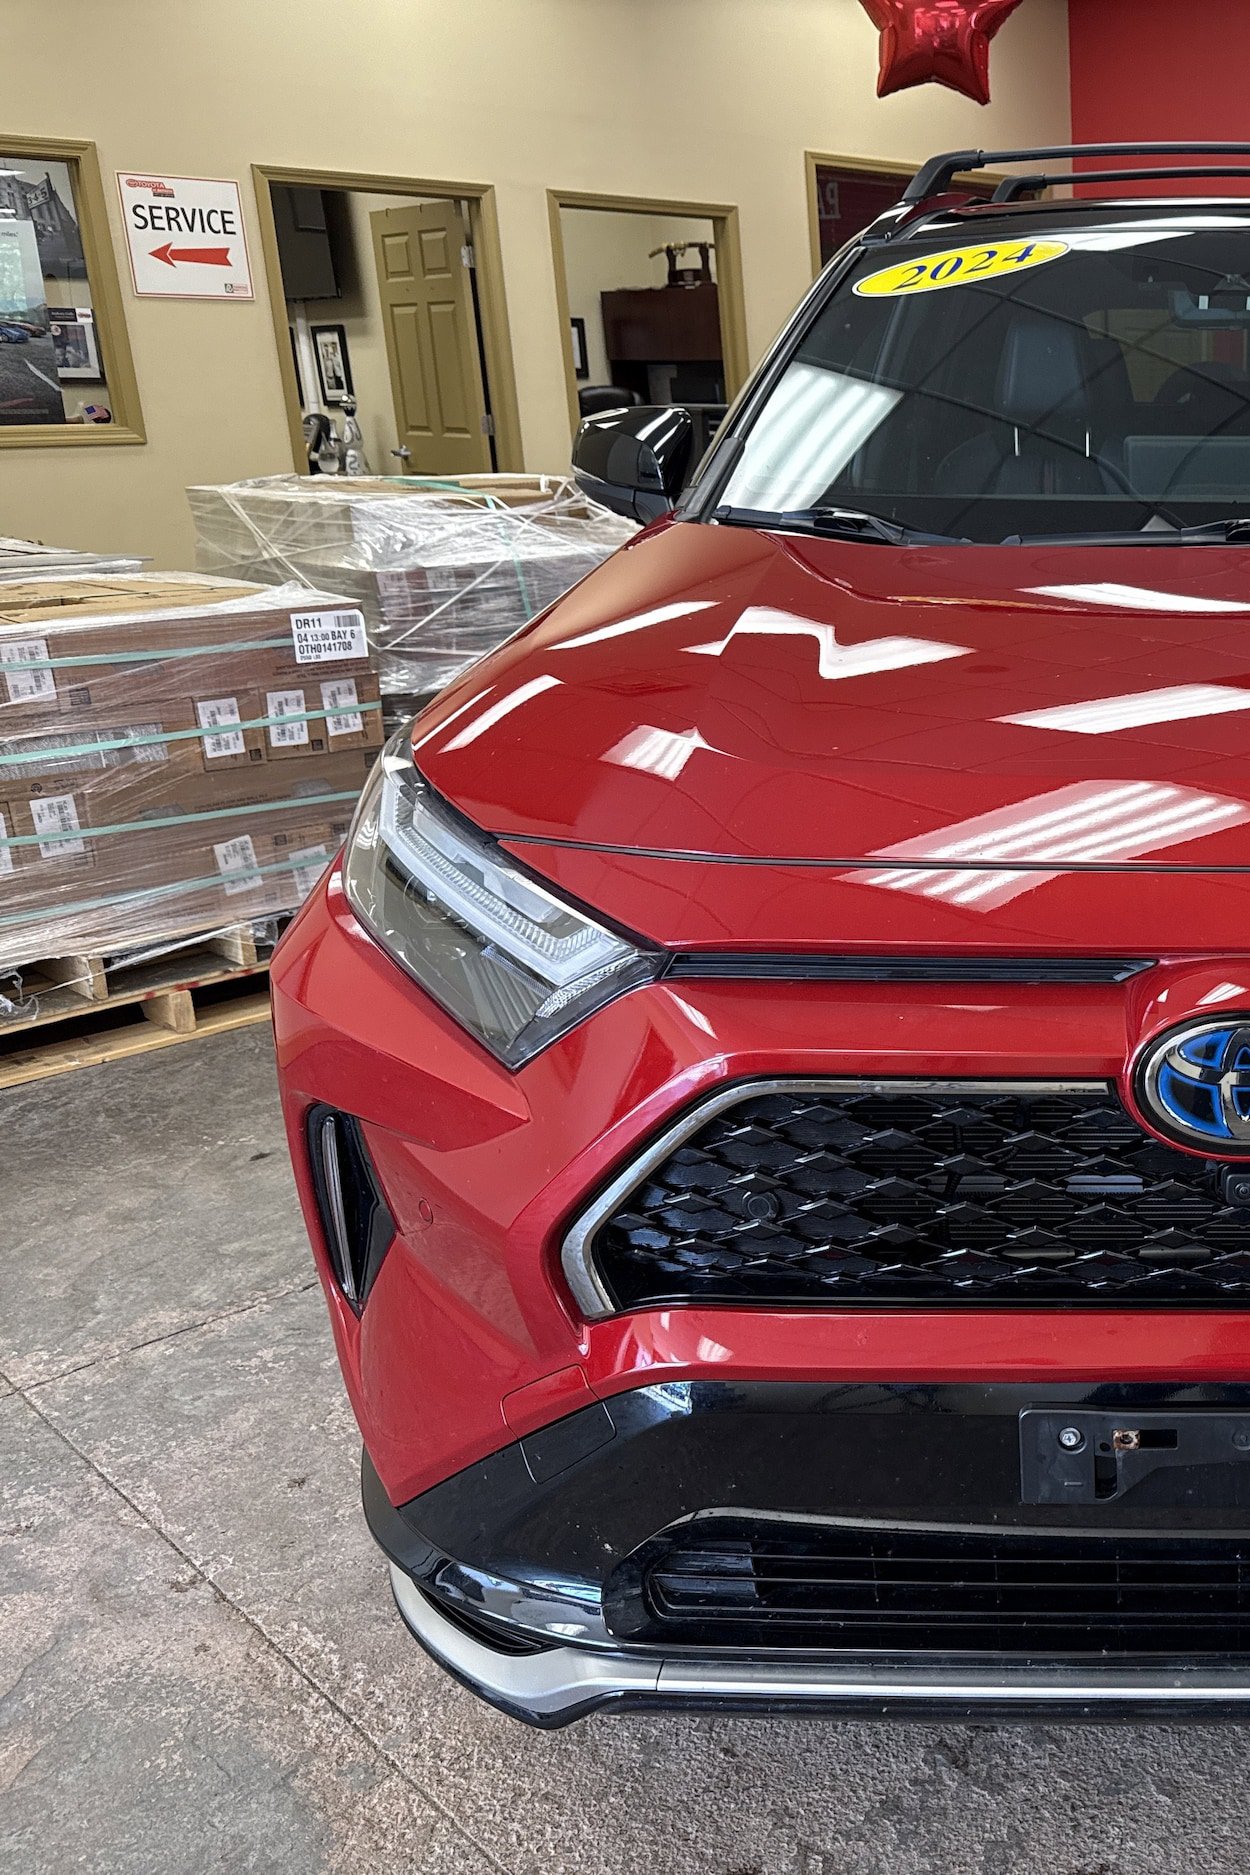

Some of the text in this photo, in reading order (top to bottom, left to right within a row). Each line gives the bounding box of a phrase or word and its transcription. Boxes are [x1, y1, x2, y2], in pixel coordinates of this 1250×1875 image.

[132, 204, 237, 235] SERVICE
[891, 243, 1037, 291] 2024
[295, 618, 322, 629] DR11
[297, 629, 355, 643] 04 13:00 BAY 6
